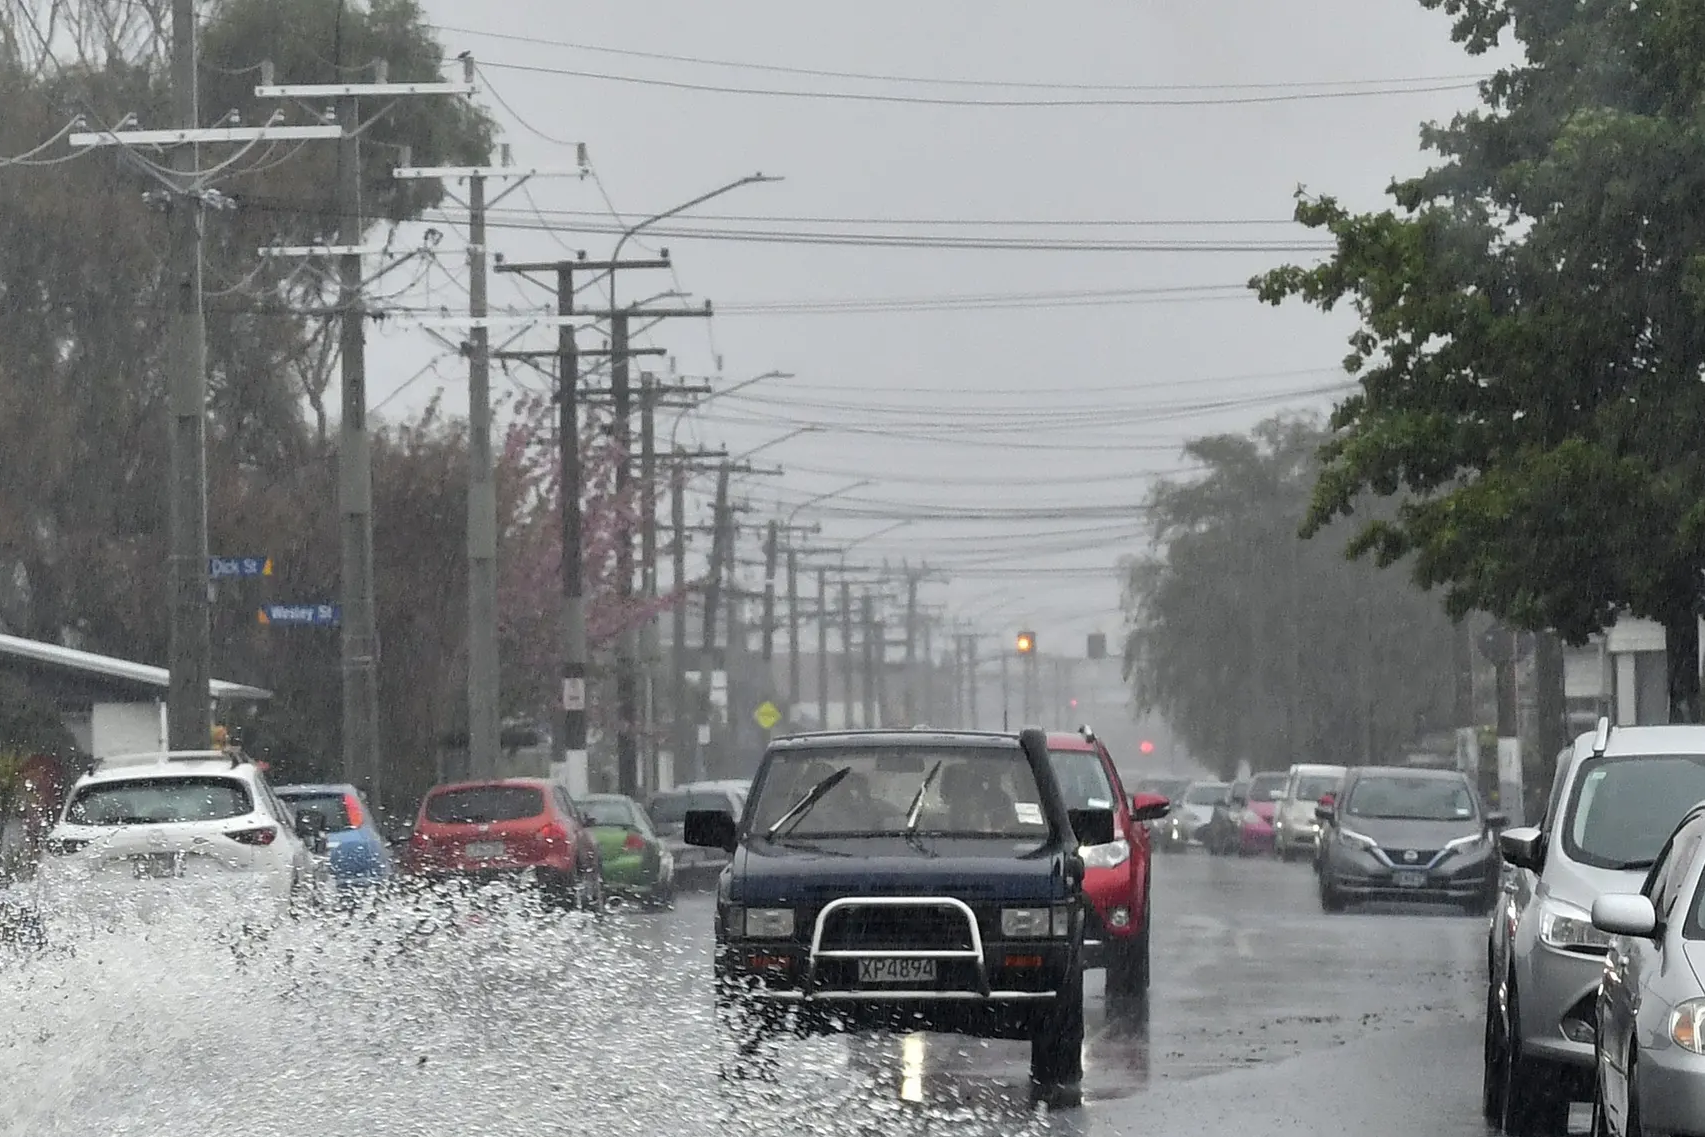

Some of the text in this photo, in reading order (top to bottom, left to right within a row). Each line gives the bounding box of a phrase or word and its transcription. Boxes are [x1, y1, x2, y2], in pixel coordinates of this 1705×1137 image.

[244, 558, 257, 573] St
[271, 605, 332, 621] Wesley St
[861, 959, 933, 979] XP4894
